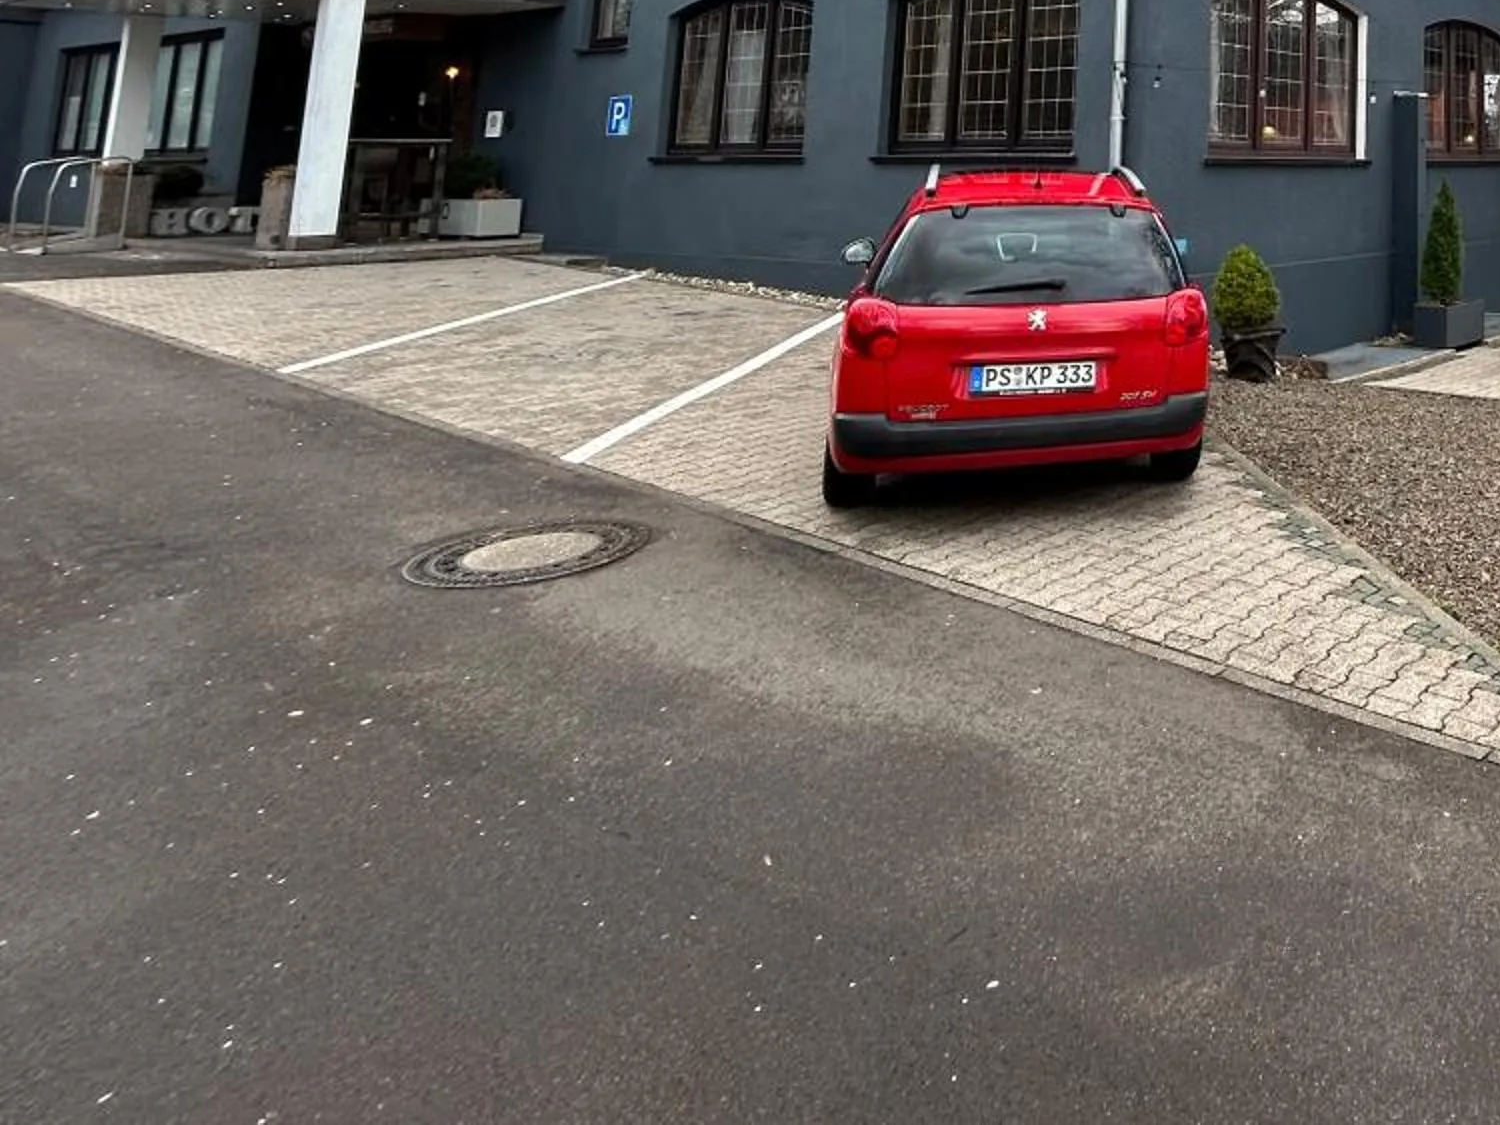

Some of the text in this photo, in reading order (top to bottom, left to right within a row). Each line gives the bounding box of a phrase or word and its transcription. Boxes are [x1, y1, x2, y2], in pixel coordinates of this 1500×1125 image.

[611, 102, 625, 131] P
[985, 364, 1093, 388] PS KP 333
